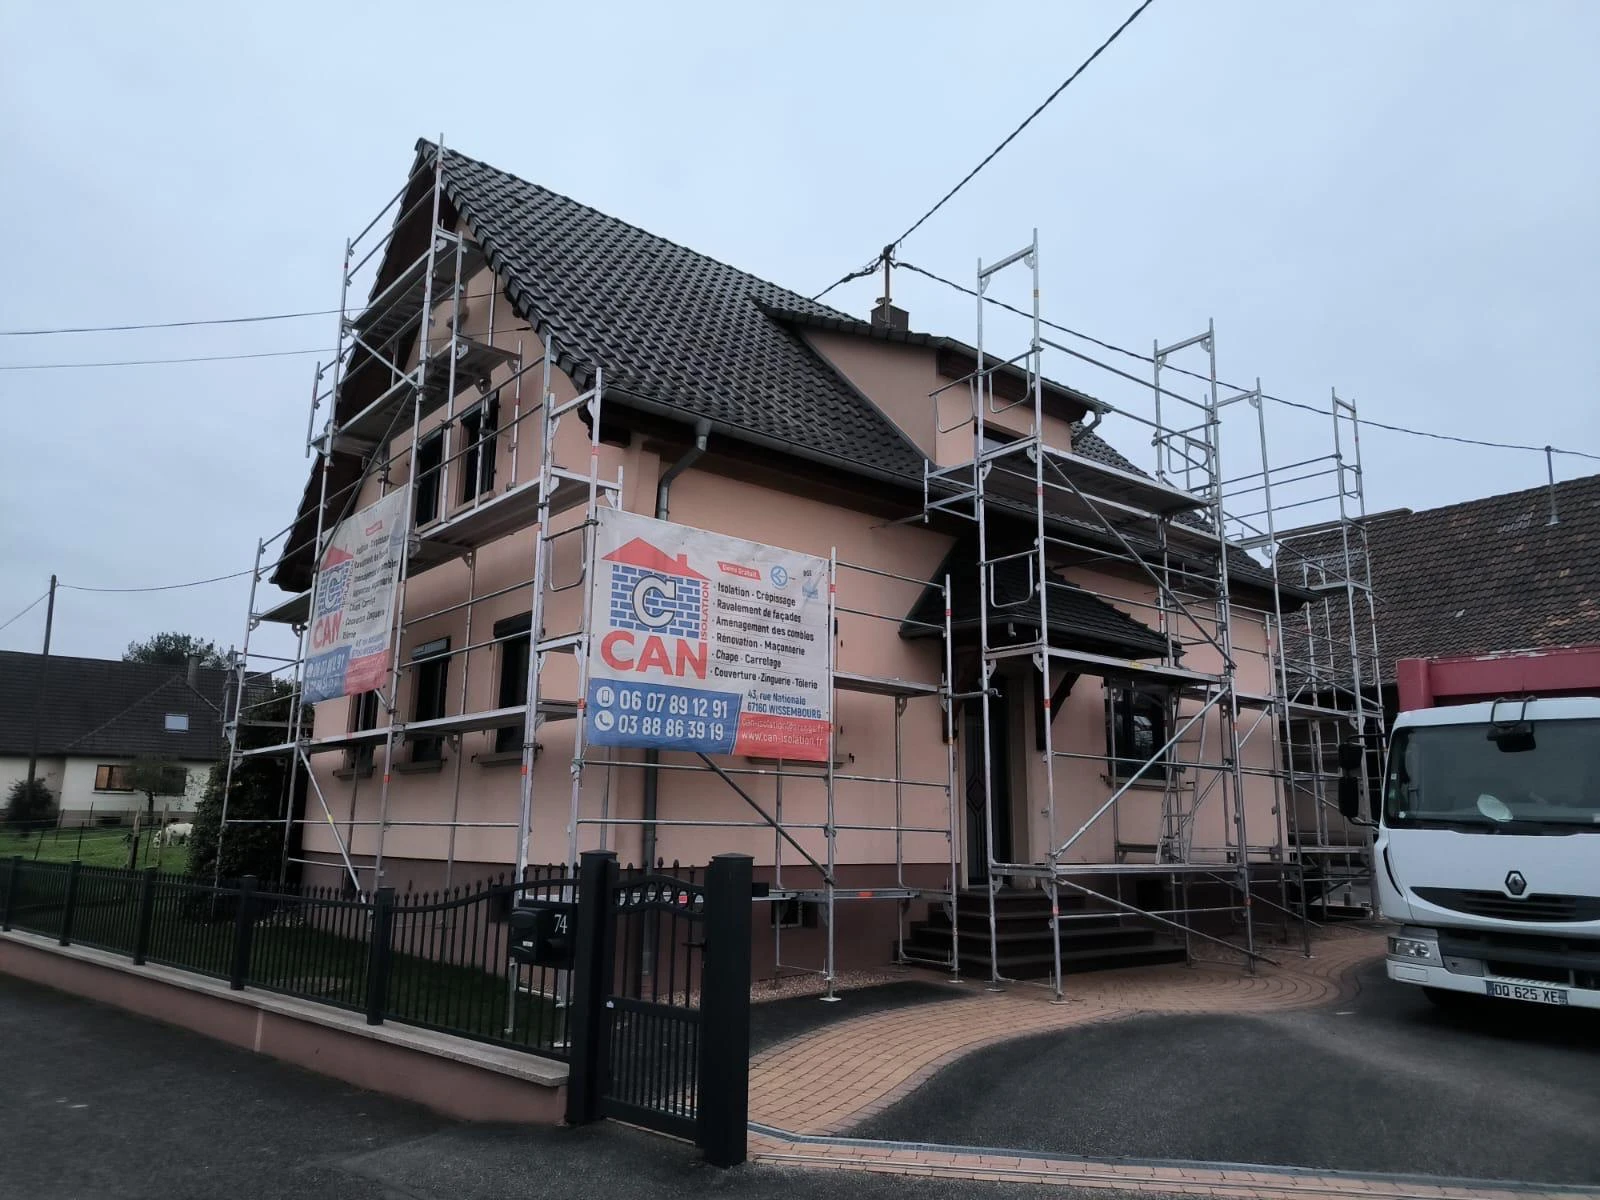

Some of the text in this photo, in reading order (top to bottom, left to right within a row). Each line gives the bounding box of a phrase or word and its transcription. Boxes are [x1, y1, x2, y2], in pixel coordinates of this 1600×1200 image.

[718, 582, 750, 598] Isolation
[756, 590, 796, 608] Crépissage
[702, 581, 710, 641] ISOLATION
[717, 599, 801, 623] Ravalement de façades
[313, 610, 343, 649] CAN
[772, 625, 785, 635] des
[787, 628, 815, 641] combles
[600, 630, 708, 680] CAN
[716, 632, 805, 656] Rénovation Maçonnerie
[715, 649, 782, 669] Chape Carrelage
[714, 667, 757, 681] Couverture
[760, 673, 791, 686] Zinguerie
[620, 690, 728, 719] 06 07 89 12 91
[747, 689, 806, 705] 43, rue Nationale
[747, 702, 822, 719] 67160 WISSEMBOURG
[618, 714, 724, 740] 03 88 86 39 19
[742, 731, 824, 747] www.can-isolation.fr
[554, 914, 568, 934] 74
